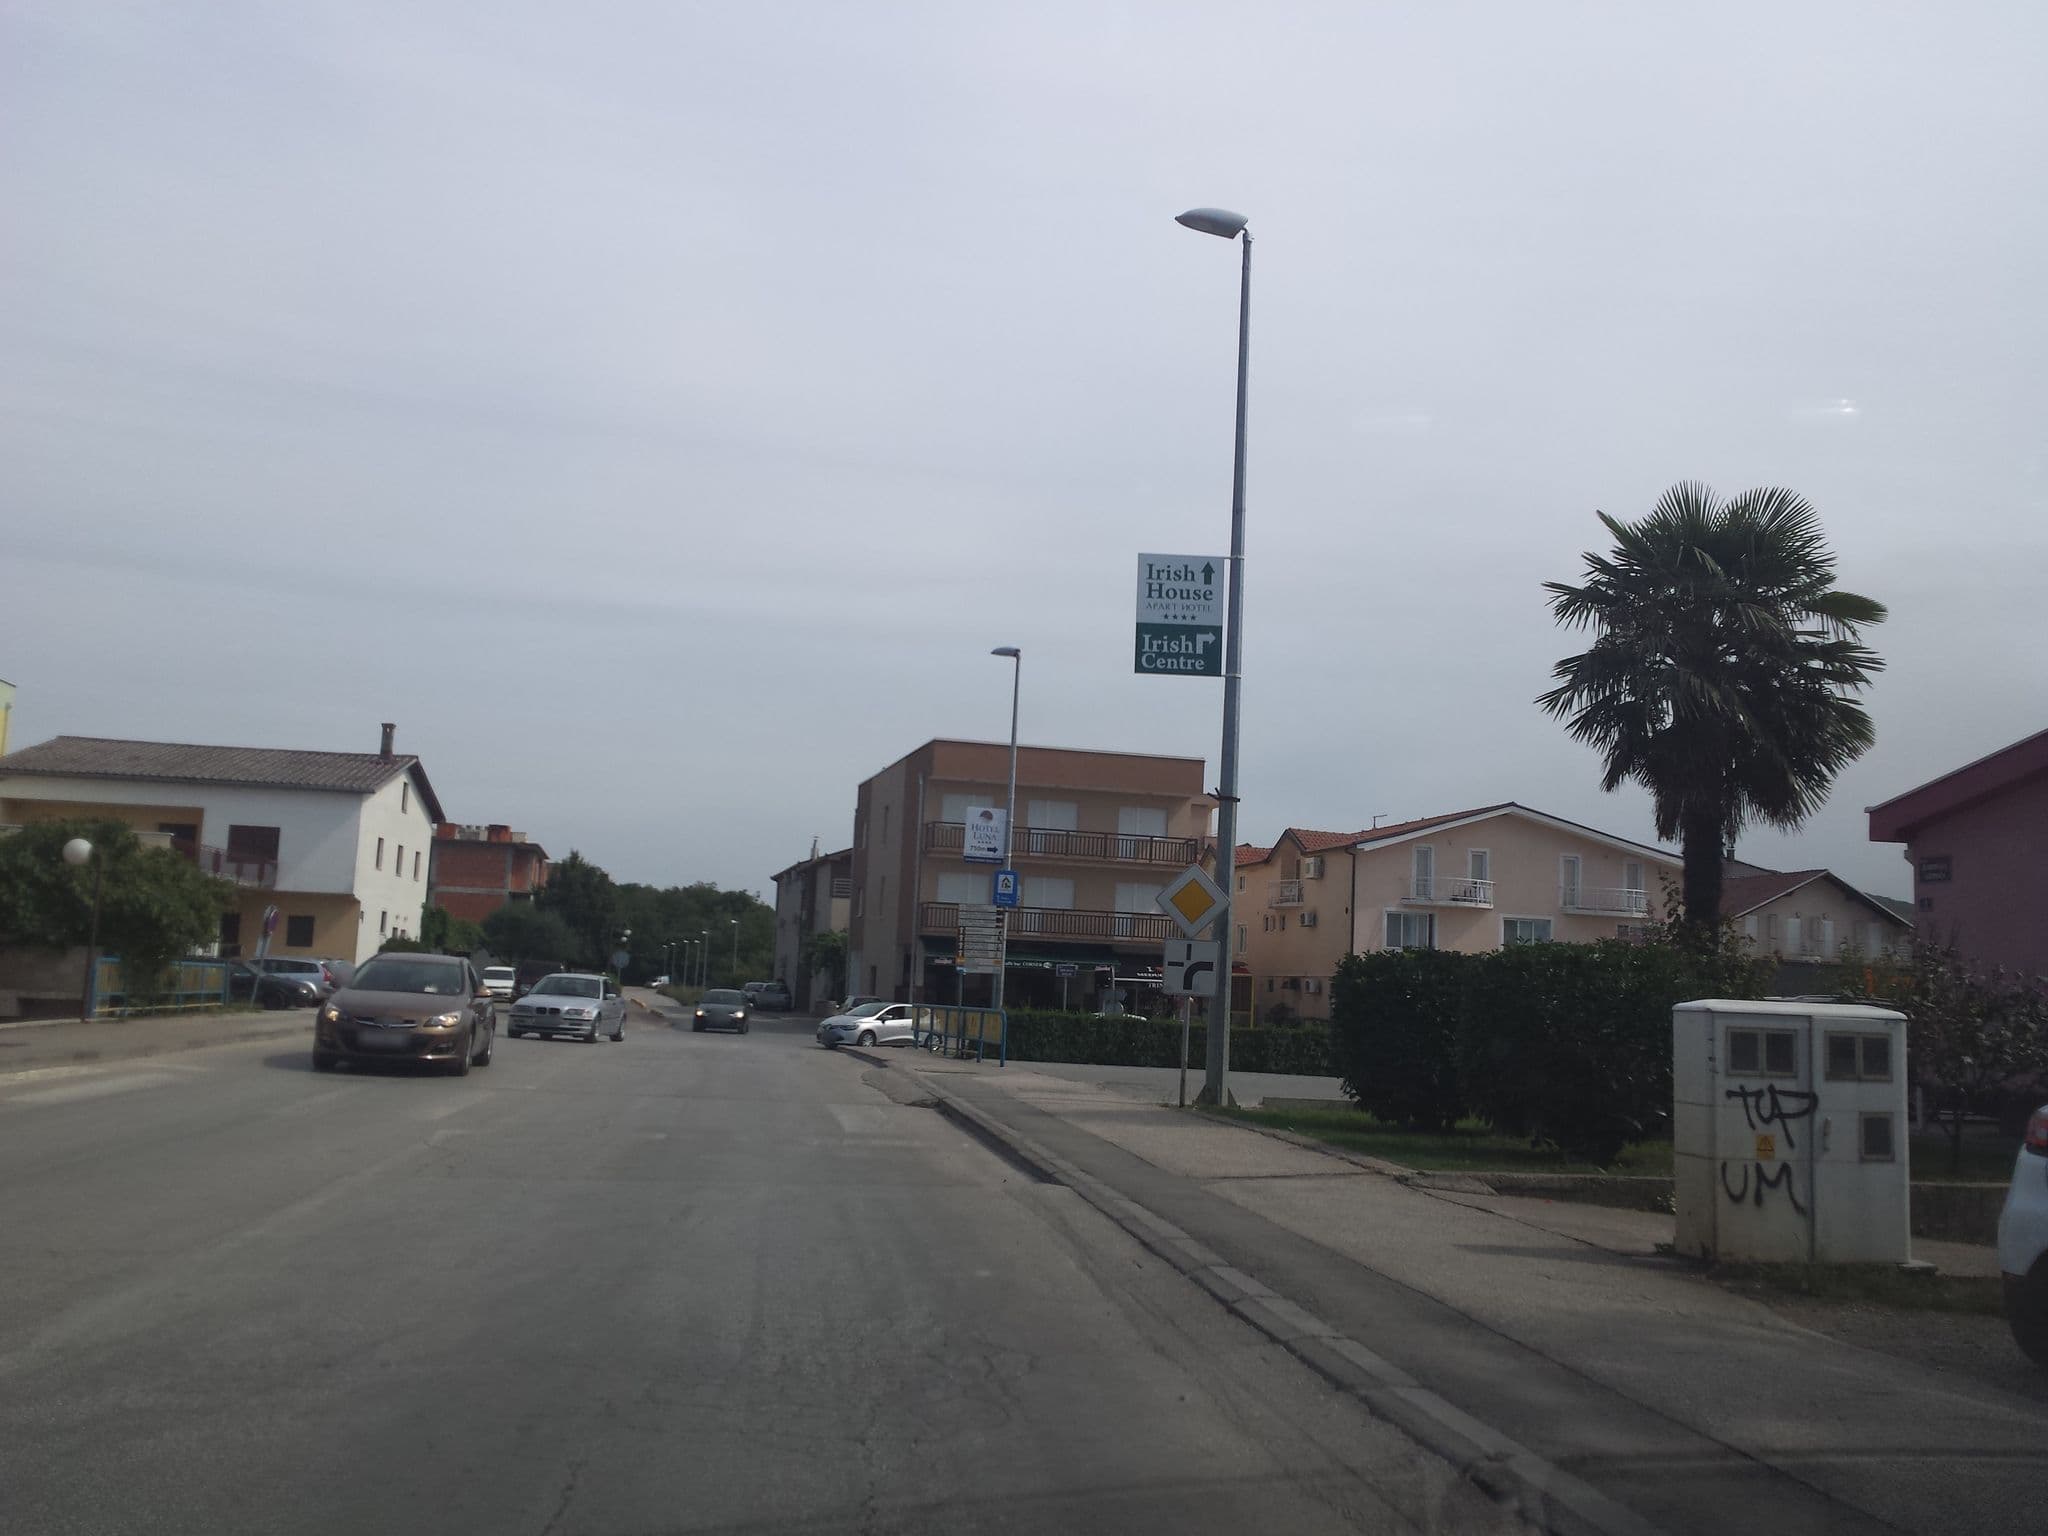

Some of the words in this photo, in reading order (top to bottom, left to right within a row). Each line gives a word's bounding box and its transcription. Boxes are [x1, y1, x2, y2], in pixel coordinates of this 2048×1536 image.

[1147, 563, 1196, 581] Irish
[1146, 582, 1213, 601] House
[1141, 634, 1194, 653] Irish
[1141, 653, 1205, 670] Centre
